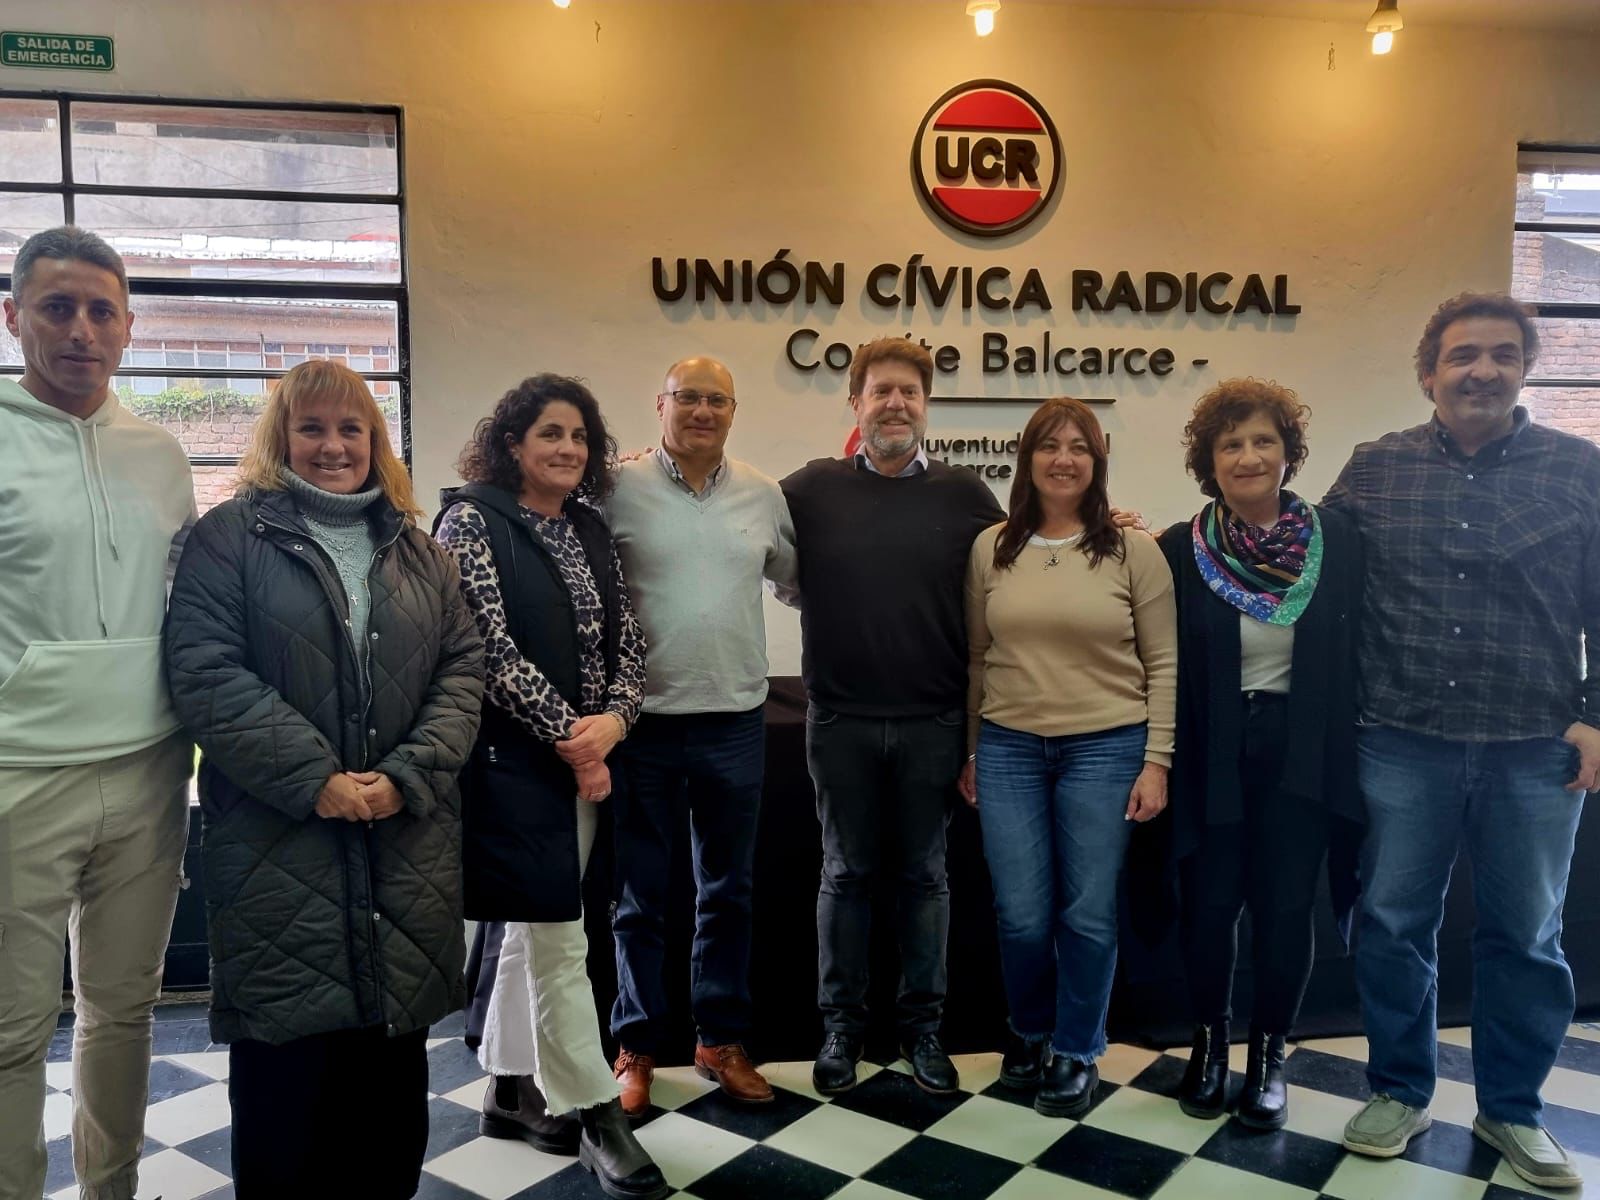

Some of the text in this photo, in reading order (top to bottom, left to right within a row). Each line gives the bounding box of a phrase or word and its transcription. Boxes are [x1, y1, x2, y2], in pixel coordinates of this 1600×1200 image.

[8, 50, 106, 65] EMERGENCIA
[17, 37, 95, 51] SALIDA DE
[935, 136, 1039, 182] UCR
[652, 248, 1302, 314] UNIÓN CÍVICA RADICAL
[982, 331, 1175, 376] Balcarce
